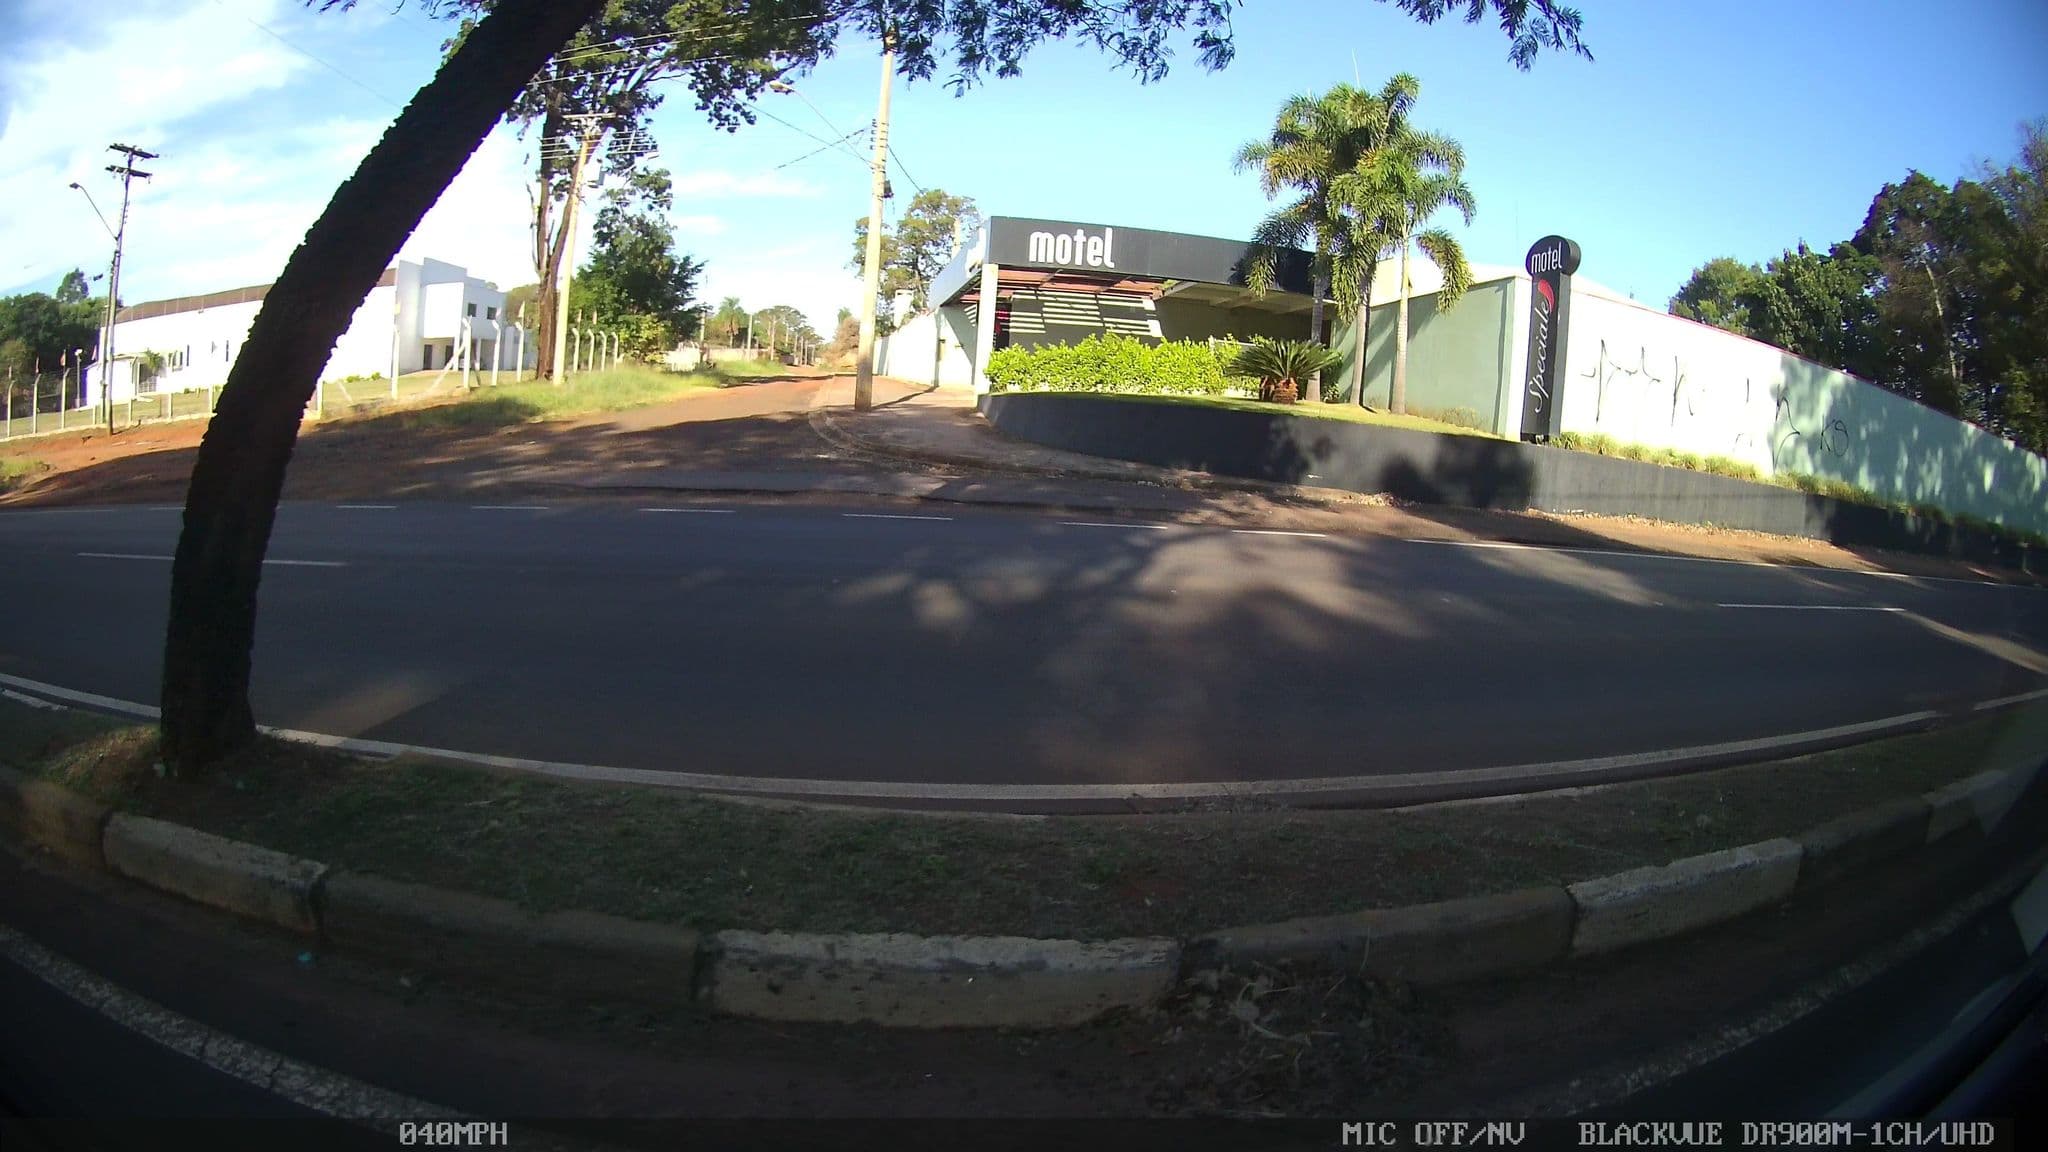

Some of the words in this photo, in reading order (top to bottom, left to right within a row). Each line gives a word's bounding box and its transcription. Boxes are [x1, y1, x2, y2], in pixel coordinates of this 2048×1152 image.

[1029, 227, 1115, 268] motel
[1531, 241, 1563, 274] motel
[1529, 299, 1552, 413] Speciale
